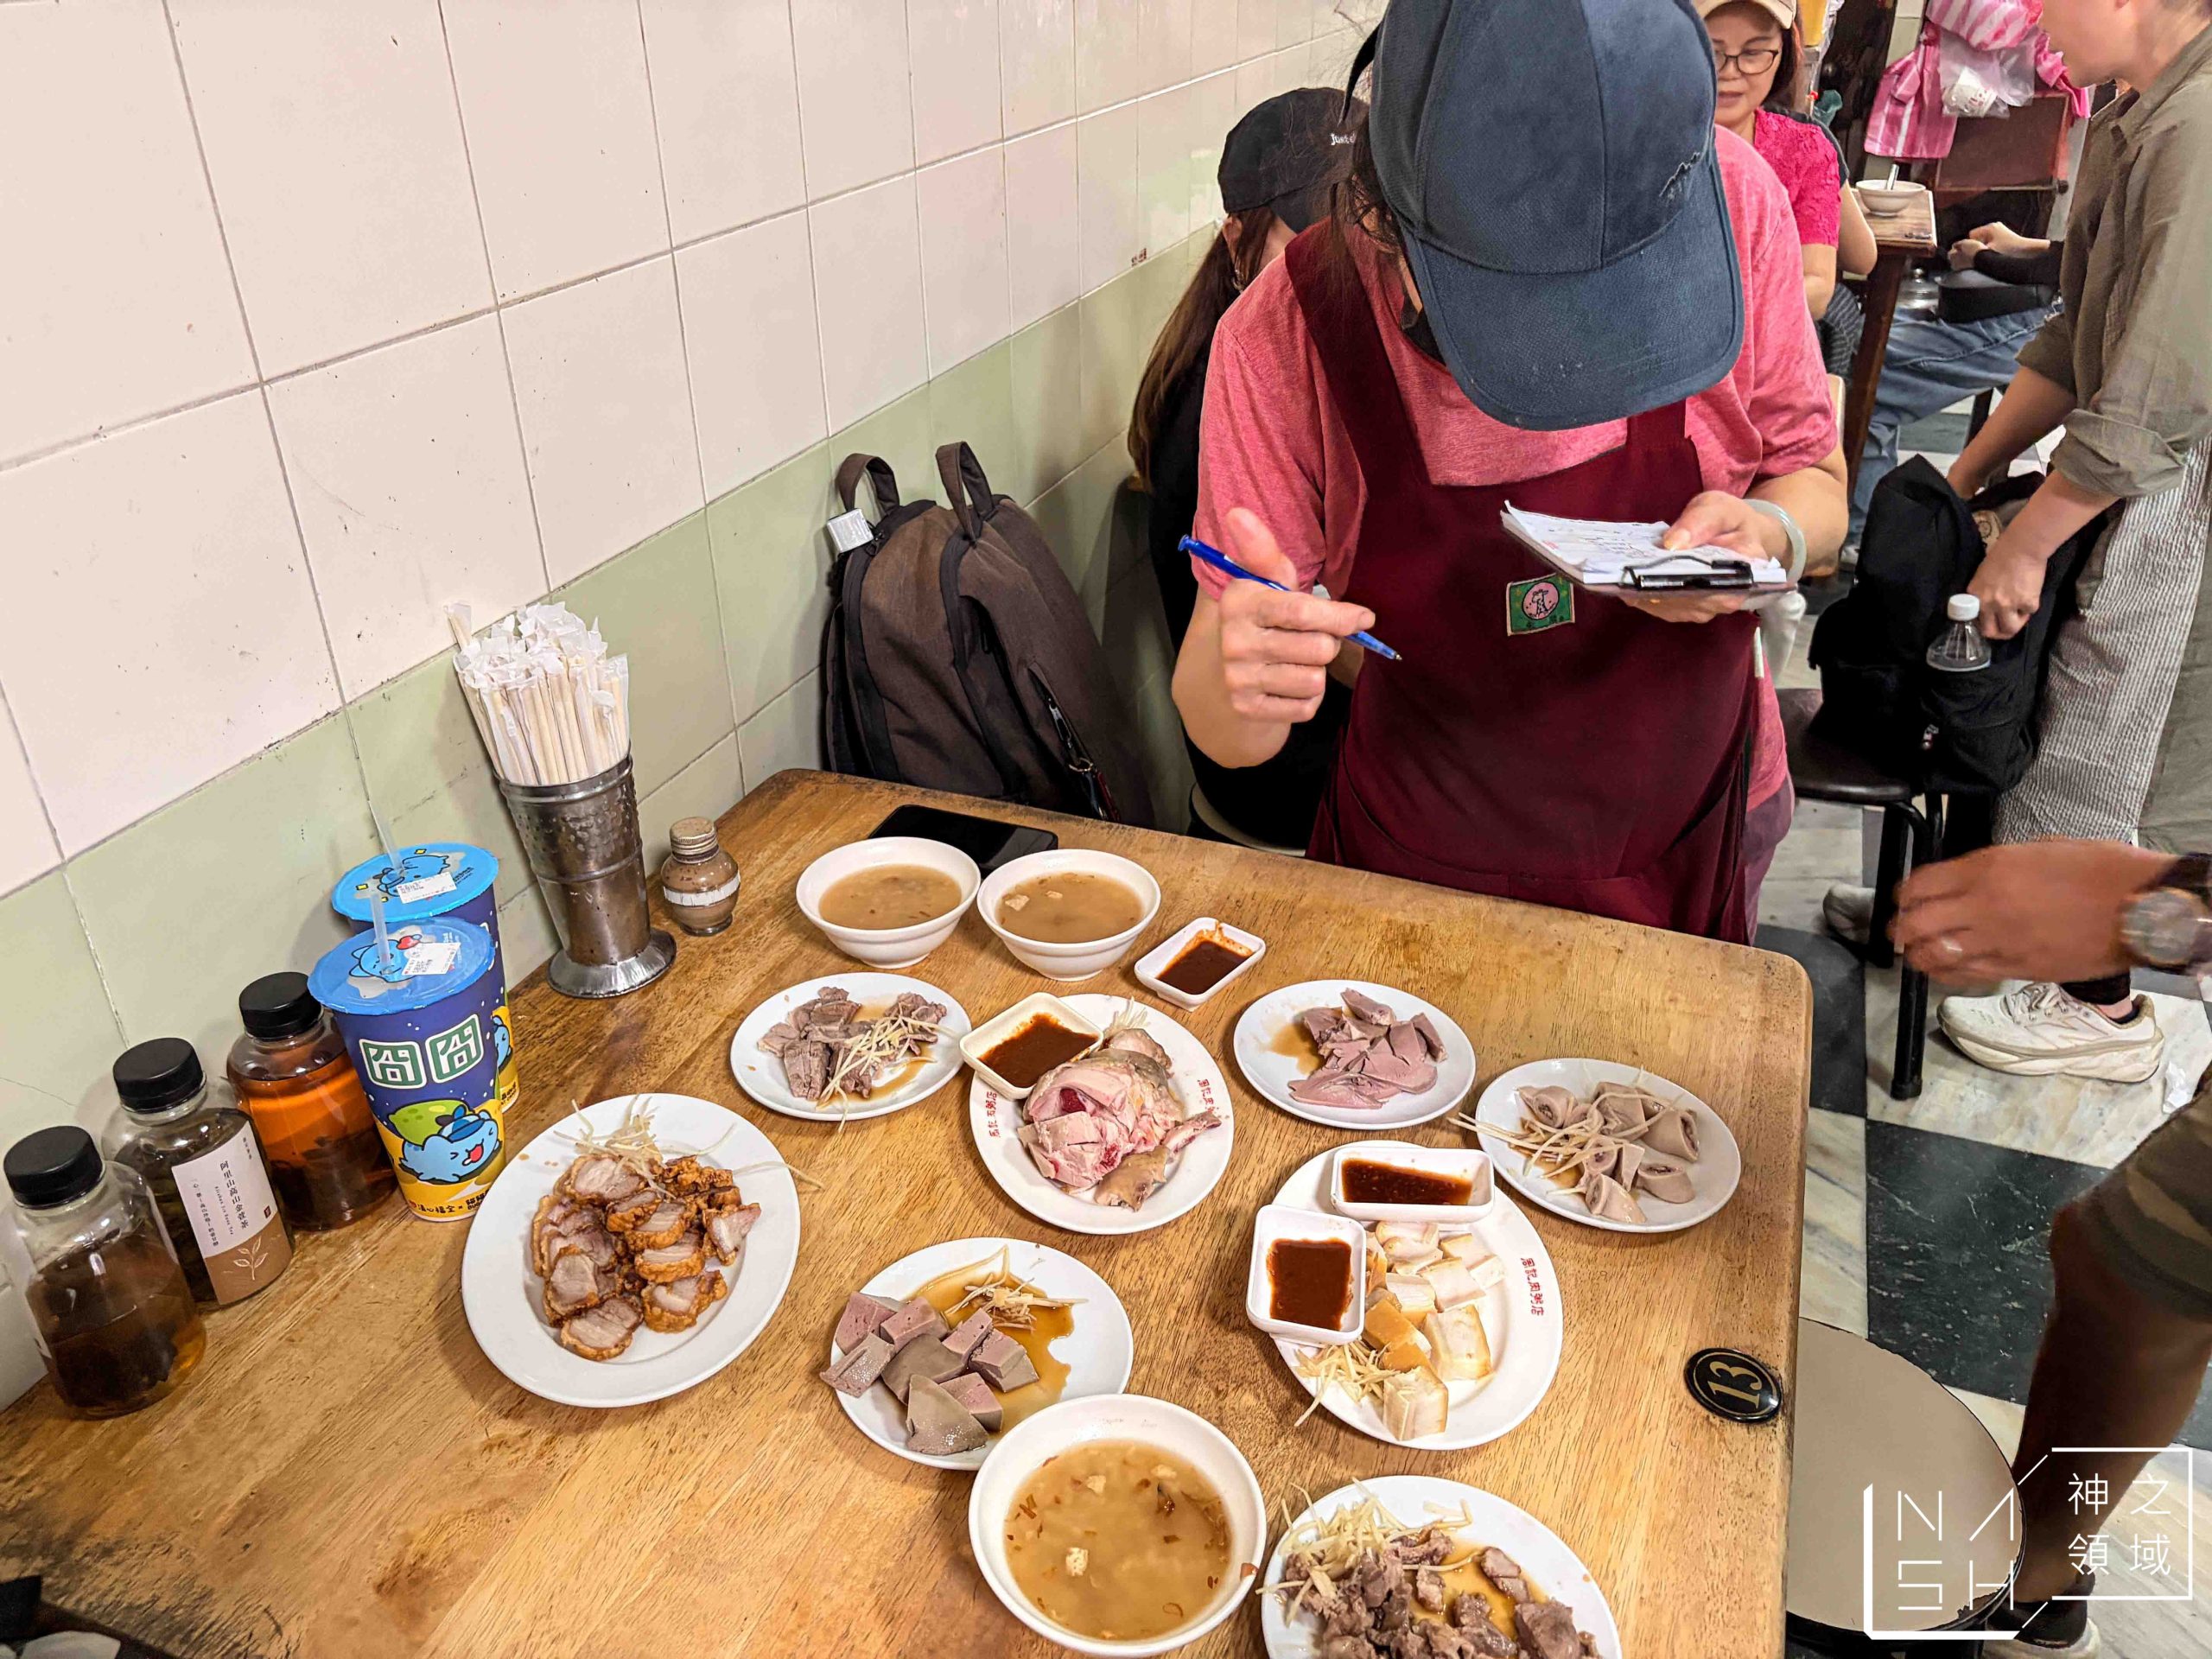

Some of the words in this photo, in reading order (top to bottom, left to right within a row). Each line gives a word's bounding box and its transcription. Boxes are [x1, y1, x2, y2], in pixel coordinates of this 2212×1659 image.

[1331, 133, 1348, 146] Just
[1521, 1257, 1544, 1316] 周記肉粥店
[1707, 1361, 1762, 1408] 13
